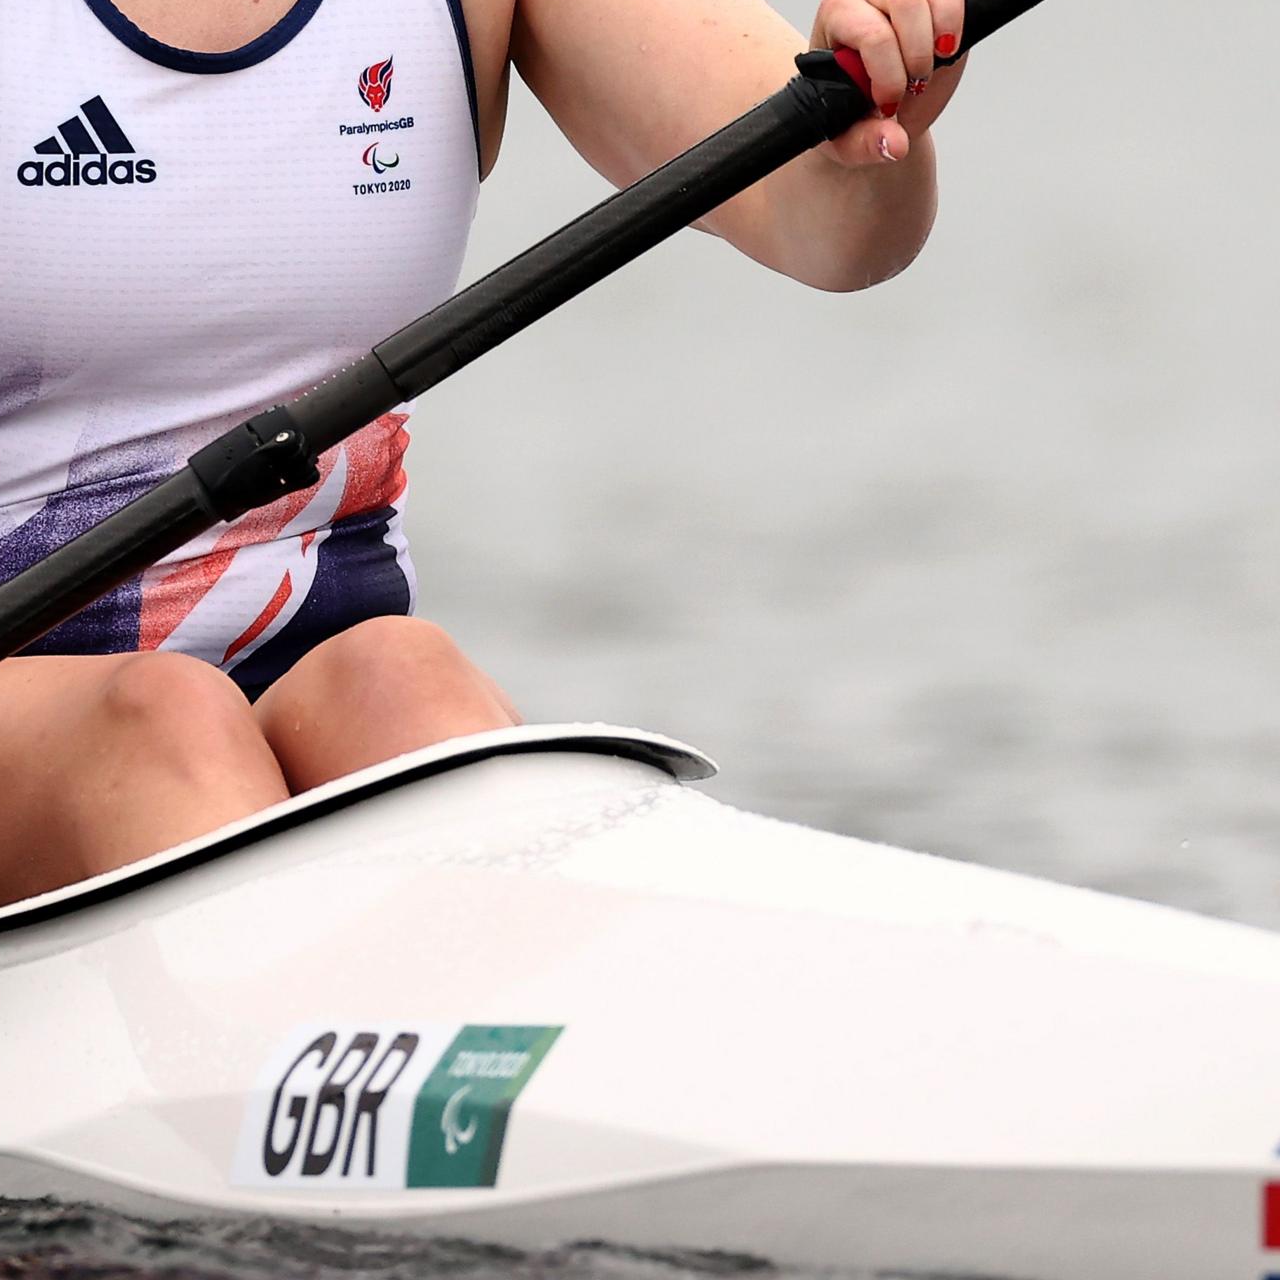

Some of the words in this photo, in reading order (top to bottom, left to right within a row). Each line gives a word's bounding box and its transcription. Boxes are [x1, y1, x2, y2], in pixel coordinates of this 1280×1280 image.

[339, 117, 414, 135] ParalympicsGB
[18, 154, 157, 186] adidas
[353, 182, 387, 195] TOKYO
[388, 179, 411, 192] 2020
[262, 1031, 420, 1178] GBR
